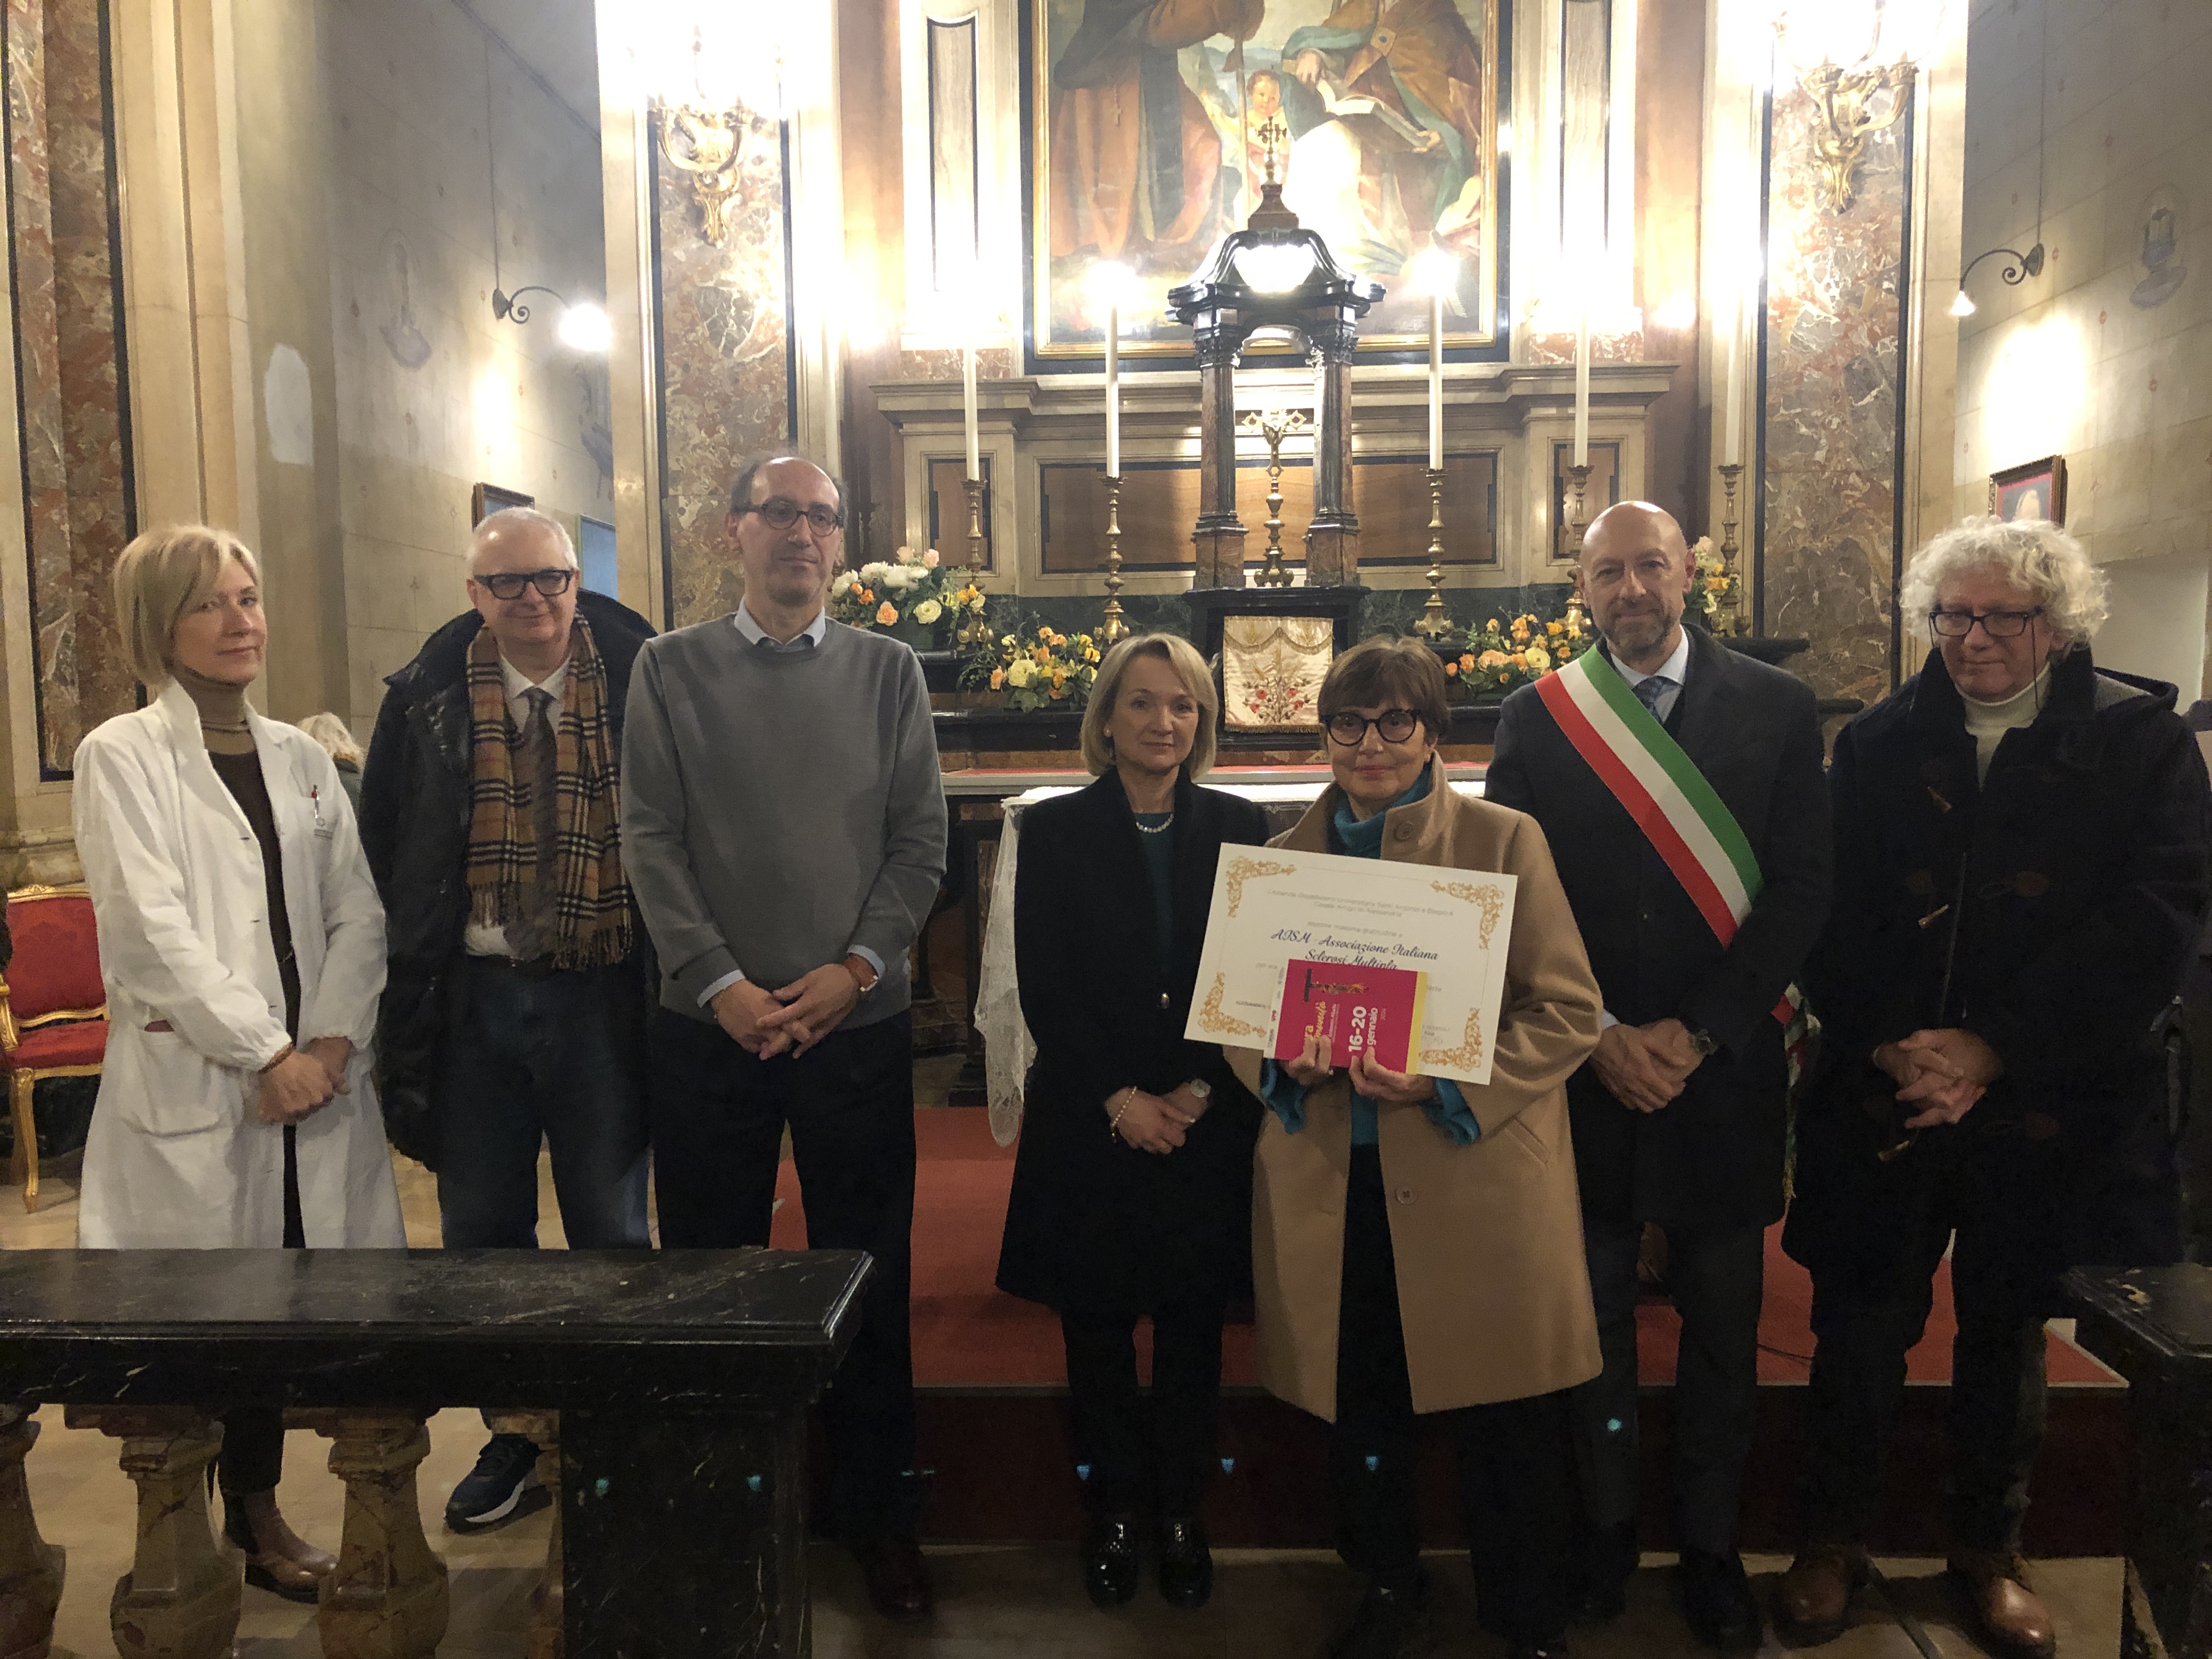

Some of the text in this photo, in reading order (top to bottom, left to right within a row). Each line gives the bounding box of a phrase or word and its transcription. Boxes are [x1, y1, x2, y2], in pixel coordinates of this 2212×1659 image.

[1305, 949, 1348, 964] Sclerosi
[1319, 935, 1389, 954] Associazione
[1391, 943, 1439, 961] Italiana
[1348, 1006, 1367, 1052] 16-20
[1367, 1007, 1378, 1045] gennaio
